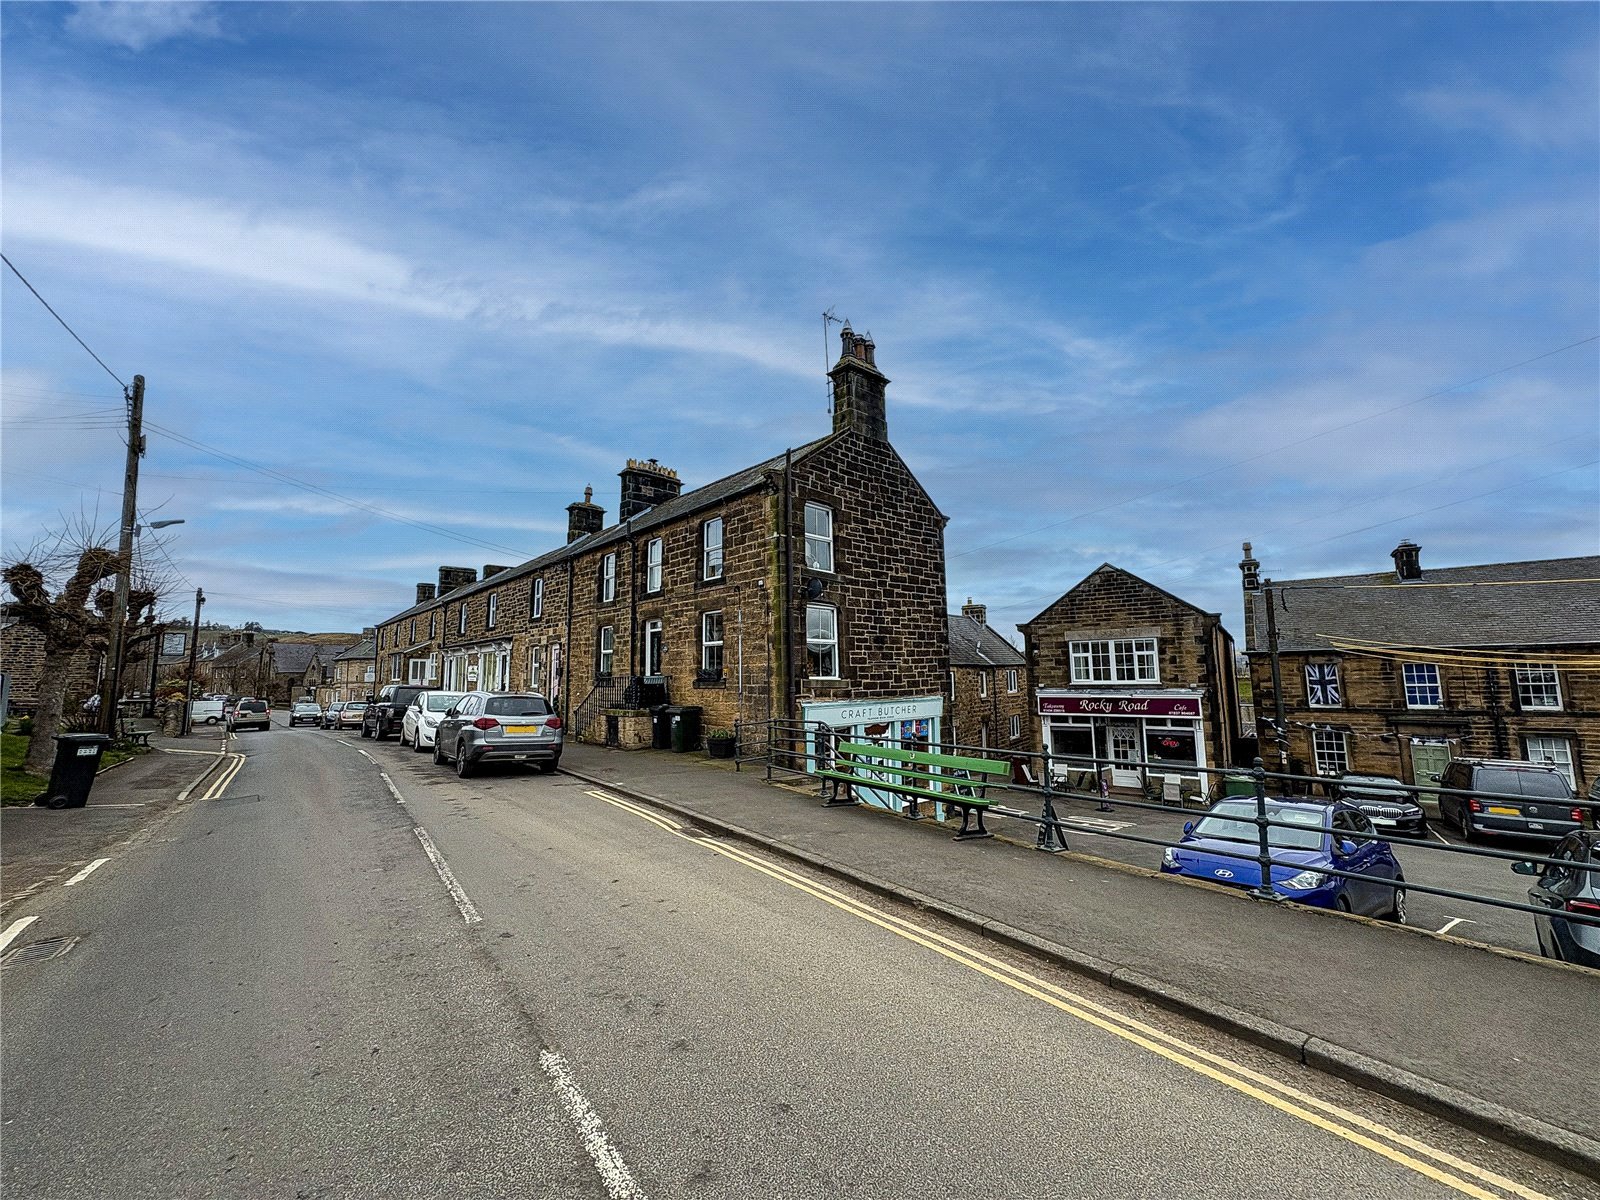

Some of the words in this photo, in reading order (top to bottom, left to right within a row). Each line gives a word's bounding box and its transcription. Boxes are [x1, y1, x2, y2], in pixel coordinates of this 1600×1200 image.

[841, 709, 872, 719] CRAFT
[878, 705, 917, 716] BUTCHER
[1080, 699, 1112, 713] Rocky
[1118, 700, 1150, 712] Road
